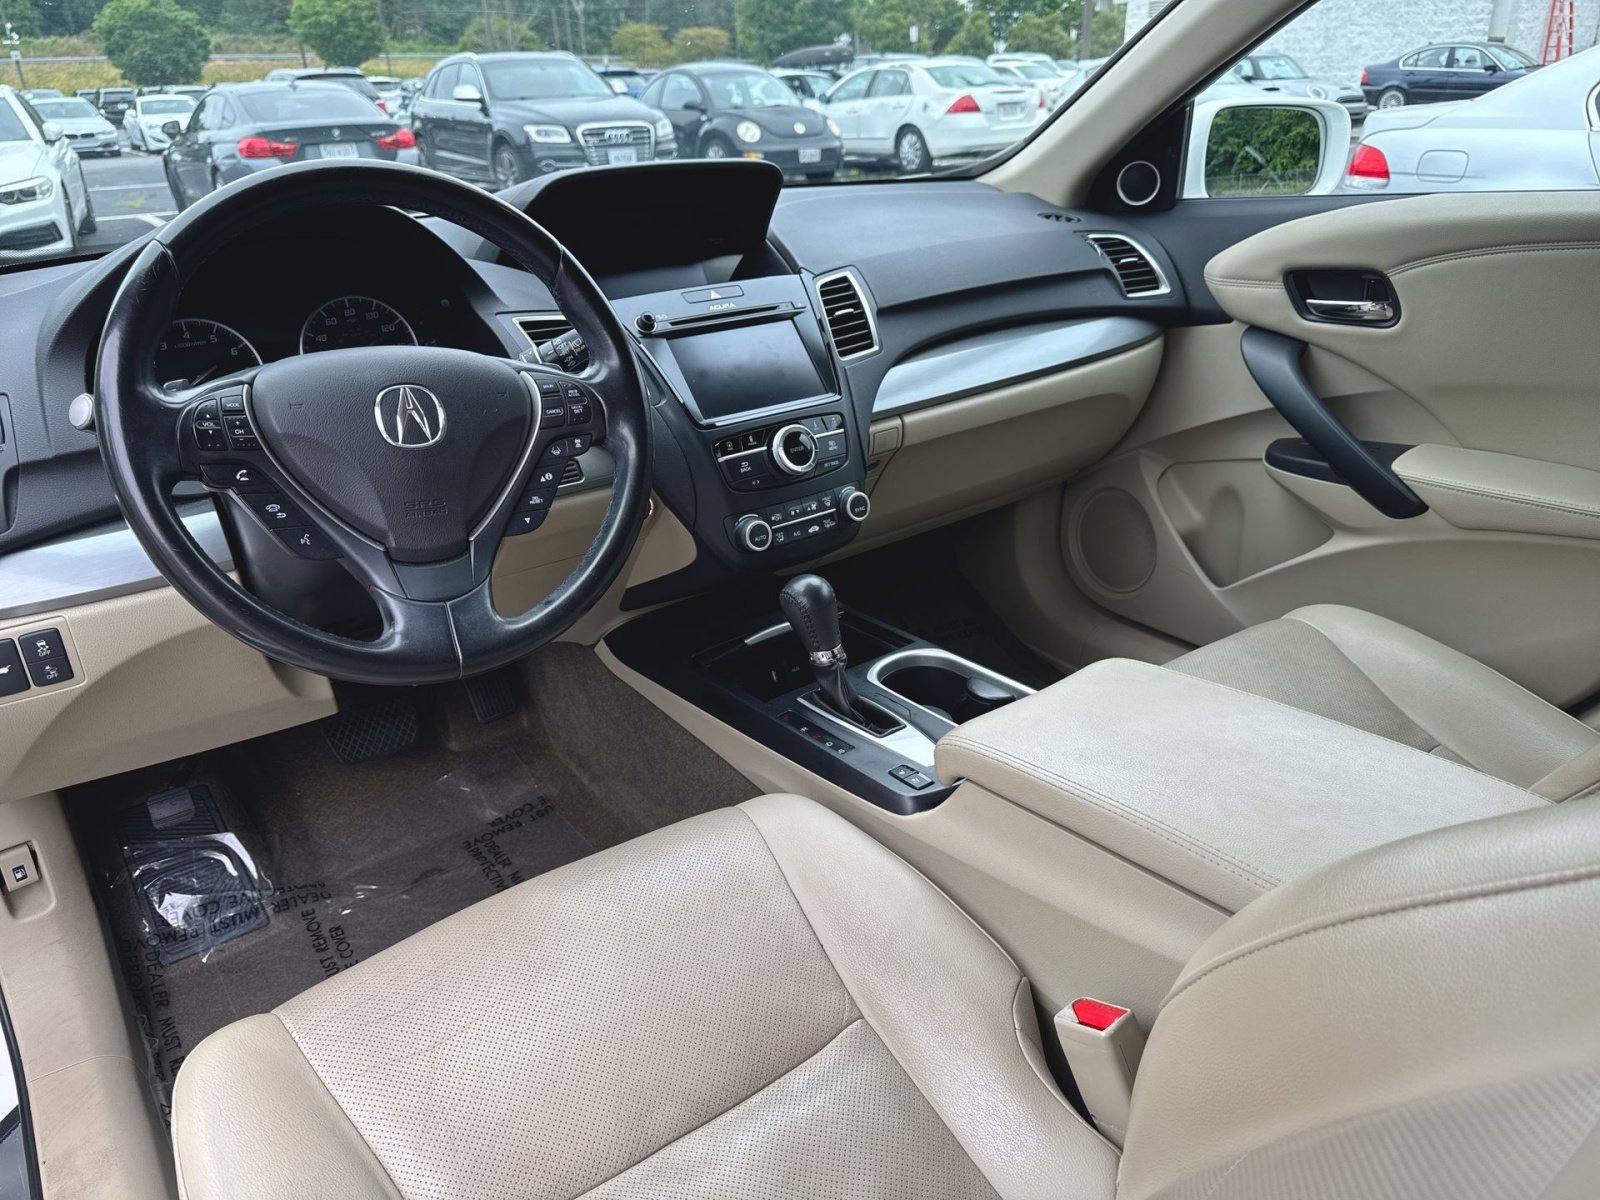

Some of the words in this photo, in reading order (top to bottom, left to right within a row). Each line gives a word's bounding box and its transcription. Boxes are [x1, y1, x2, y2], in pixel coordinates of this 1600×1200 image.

[709, 302, 737, 311] ACURA
[344, 308, 356, 317] 80
[365, 311, 379, 320] 100
[325, 317, 337, 326] 60
[381, 323, 395, 332] 120
[183, 331, 190, 339] 4
[209, 334, 218, 343] 5
[315, 334, 328, 342] 40
[160, 342, 168, 351] 3
[230, 347, 238, 356] 6
[754, 534, 767, 542] AUTO
[488, 802, 535, 828] COVER
[530, 805, 554, 822] UST
[462, 820, 523, 853] REMOVE
[467, 846, 507, 890] PROTECTIV
[271, 891, 332, 914] DEALER
[210, 906, 260, 937] MUST
[301, 907, 330, 953] REMOVE
[329, 925, 353, 960] COVER
[319, 956, 340, 978] UST
[145, 950, 171, 1009] DEALER
[158, 1016, 182, 1052] MUST
